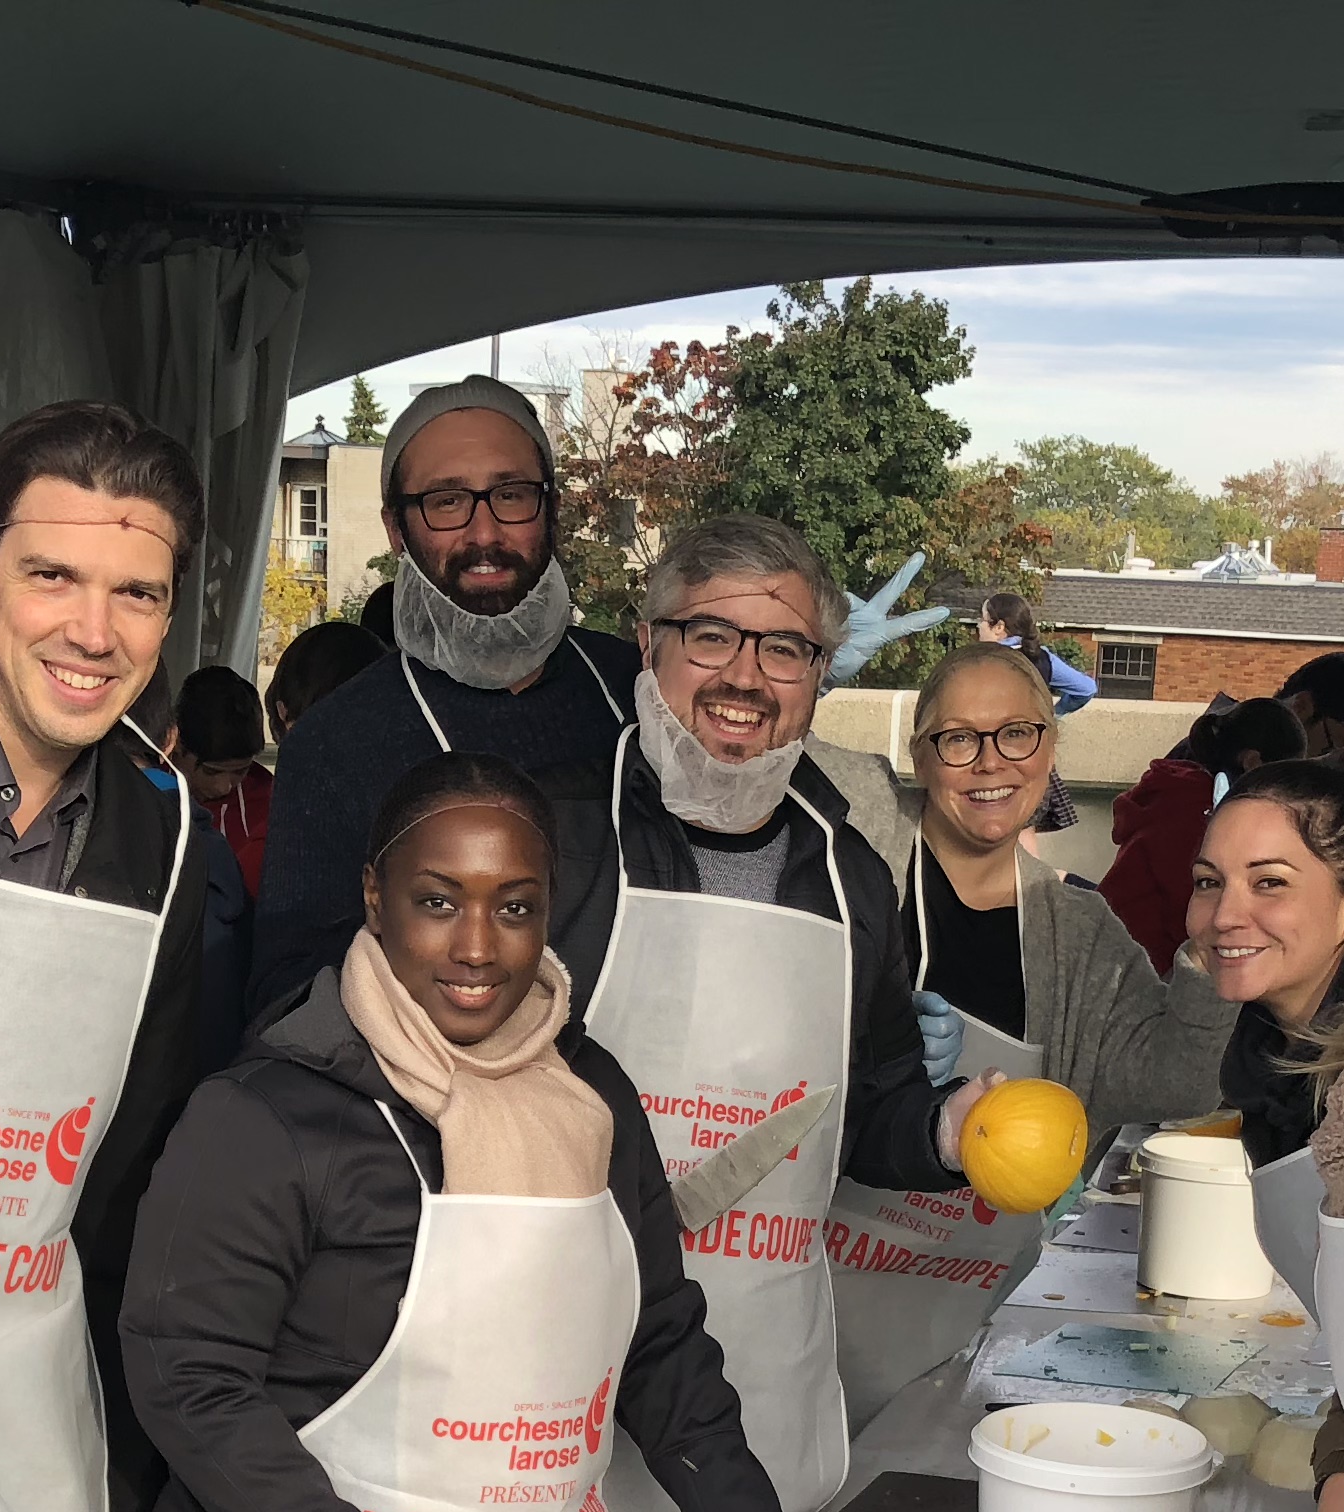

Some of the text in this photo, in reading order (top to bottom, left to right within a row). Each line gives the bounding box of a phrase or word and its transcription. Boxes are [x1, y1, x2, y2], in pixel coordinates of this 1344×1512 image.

[7, 1107, 33, 1120] SINCE
[915, 1254, 1010, 1291] COUPE
[514, 1402, 545, 1412] DEPUIS
[432, 1415, 585, 1442] courchesne
[509, 1444, 580, 1471] larose
